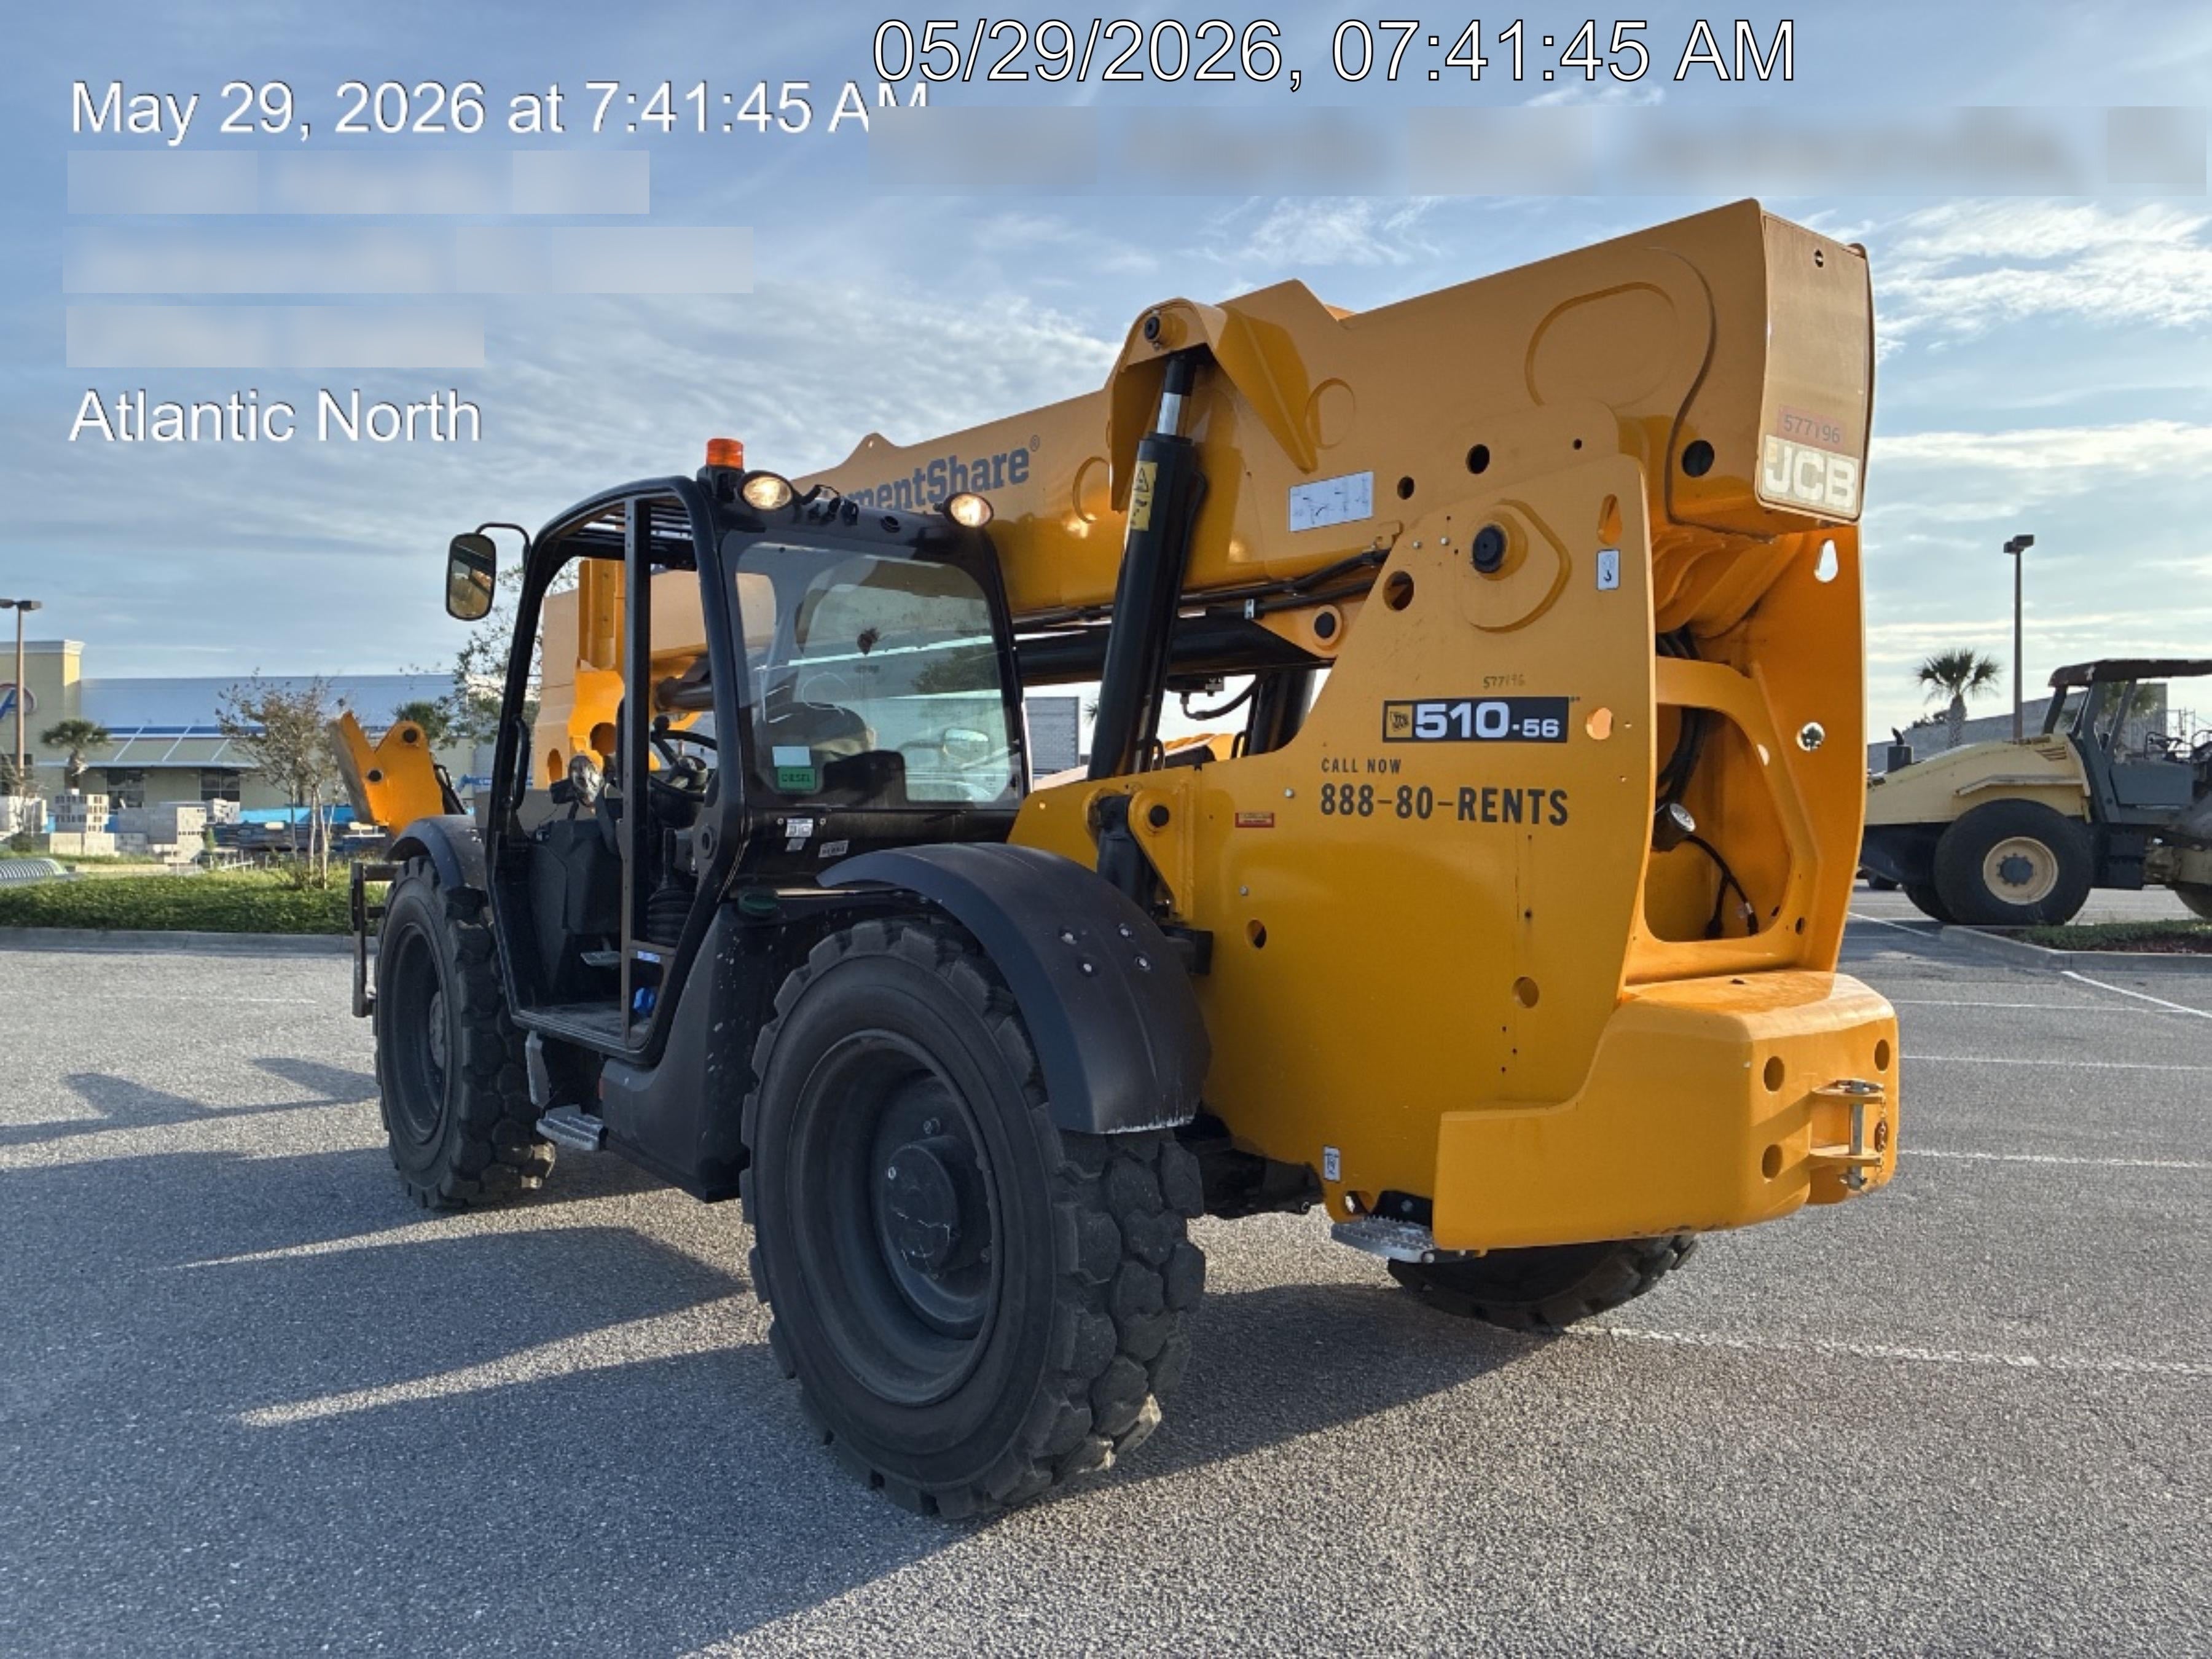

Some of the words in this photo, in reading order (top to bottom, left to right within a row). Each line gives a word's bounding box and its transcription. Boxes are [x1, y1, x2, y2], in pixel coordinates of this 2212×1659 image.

[847, 447, 1030, 510] mentShare
[1765, 445, 1856, 508] JCB
[1320, 758, 1359, 773] CALL
[1367, 758, 1402, 774] NOW
[1320, 782, 1569, 827] 888-80-RENTS
